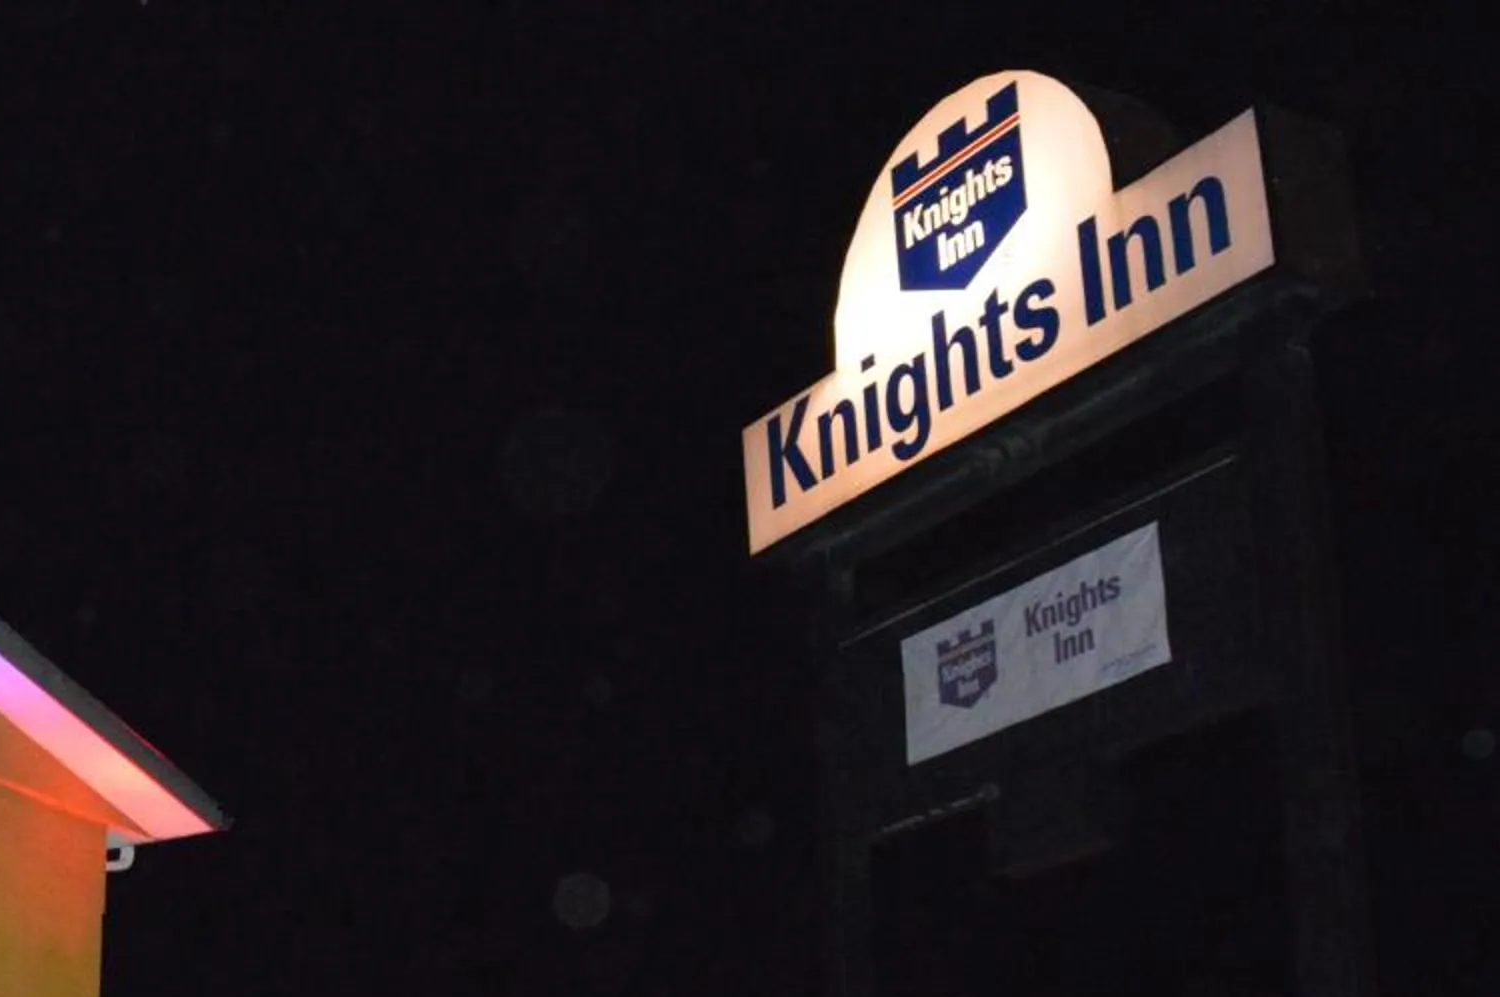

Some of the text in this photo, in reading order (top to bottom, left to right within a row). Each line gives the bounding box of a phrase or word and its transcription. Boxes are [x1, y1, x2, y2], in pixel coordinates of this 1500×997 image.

[903, 154, 1013, 250] Knights
[937, 219, 986, 272] Inn
[766, 175, 1232, 510] Knights Inn
[1023, 575, 1122, 638] Knights
[1053, 626, 1096, 665] Inn
